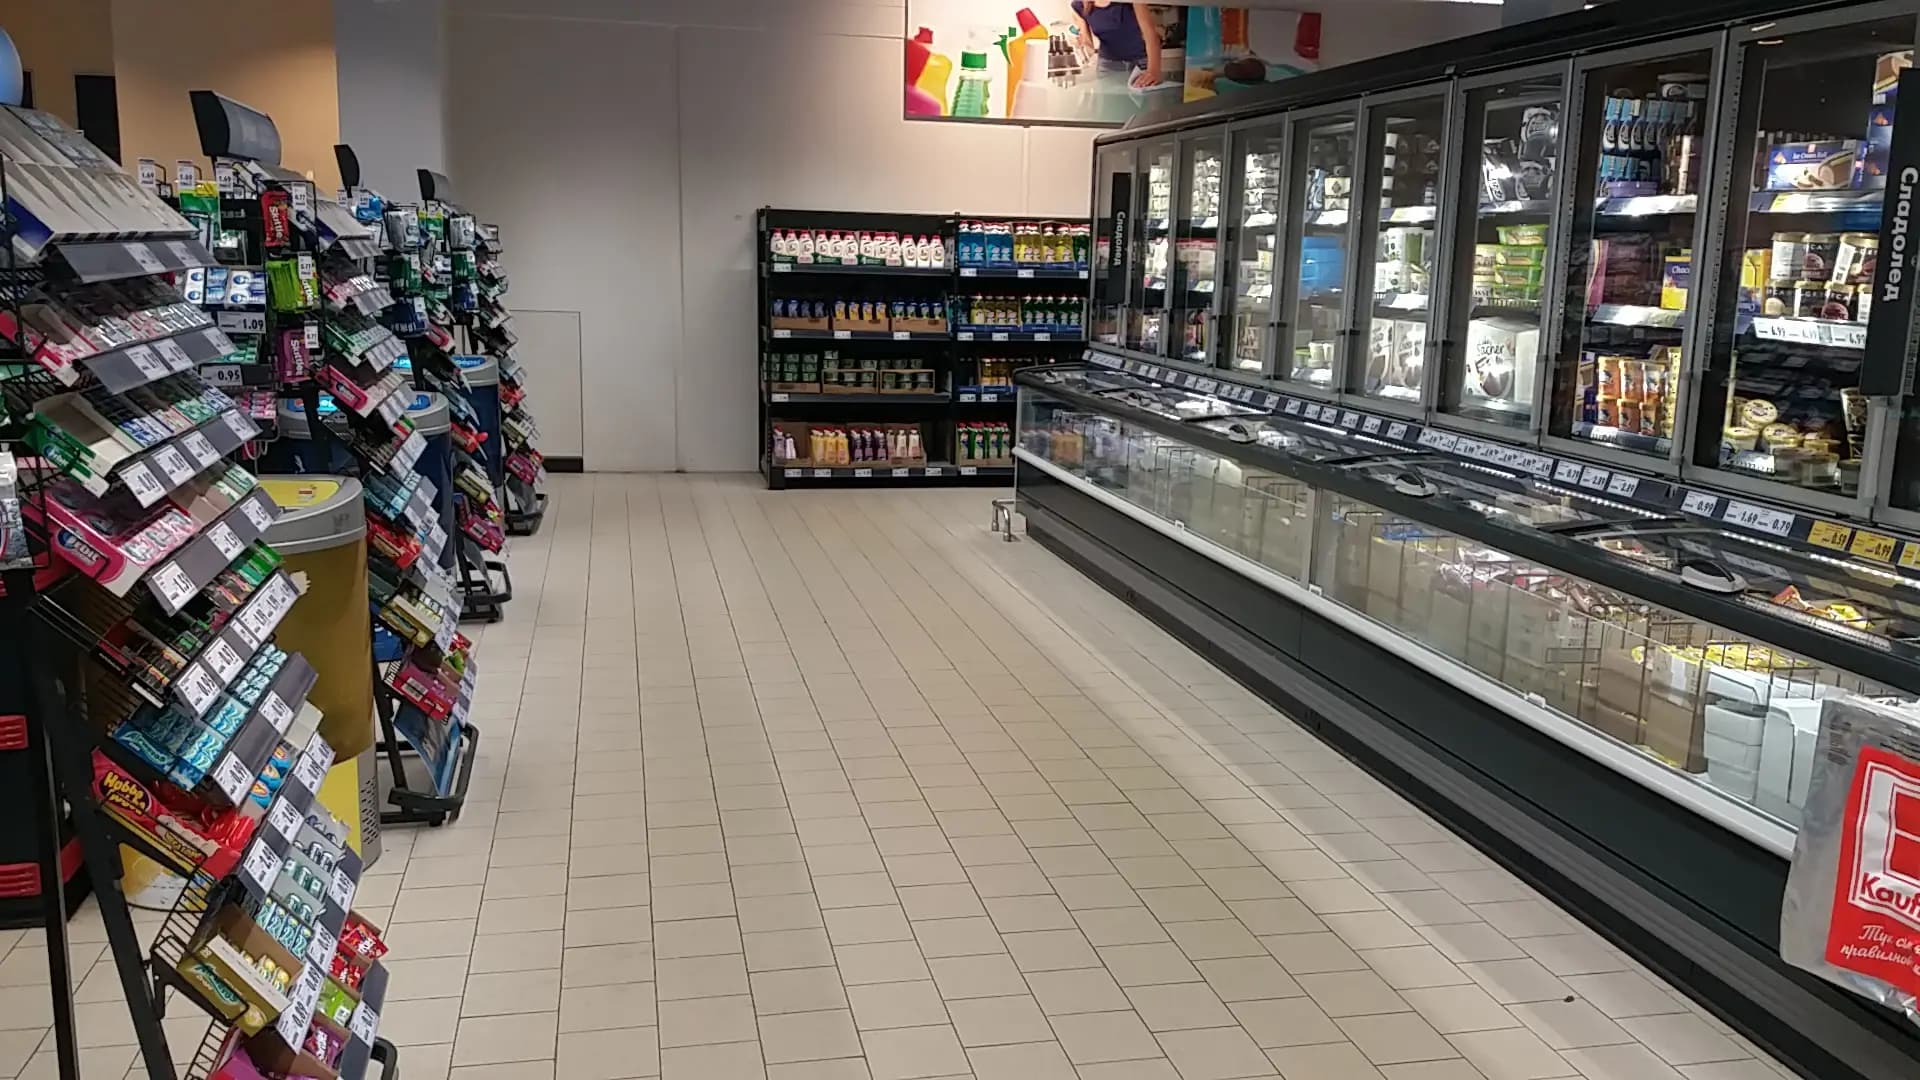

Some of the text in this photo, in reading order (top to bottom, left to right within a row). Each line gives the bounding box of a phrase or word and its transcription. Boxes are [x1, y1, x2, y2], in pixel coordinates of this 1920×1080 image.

[1113, 211, 1126, 267] Сладолед
[1883, 167, 1919, 302] Сладолед
[242, 318, 264, 330] 1.09
[217, 369, 240, 381] 0.95
[1697, 500, 1714, 513] 0.99
[1740, 511, 1758, 525] 1.69
[1772, 518, 1791, 532] 0.79
[1874, 542, 1892, 557] 0.99
[1861, 871, 1920, 919] Kauf
